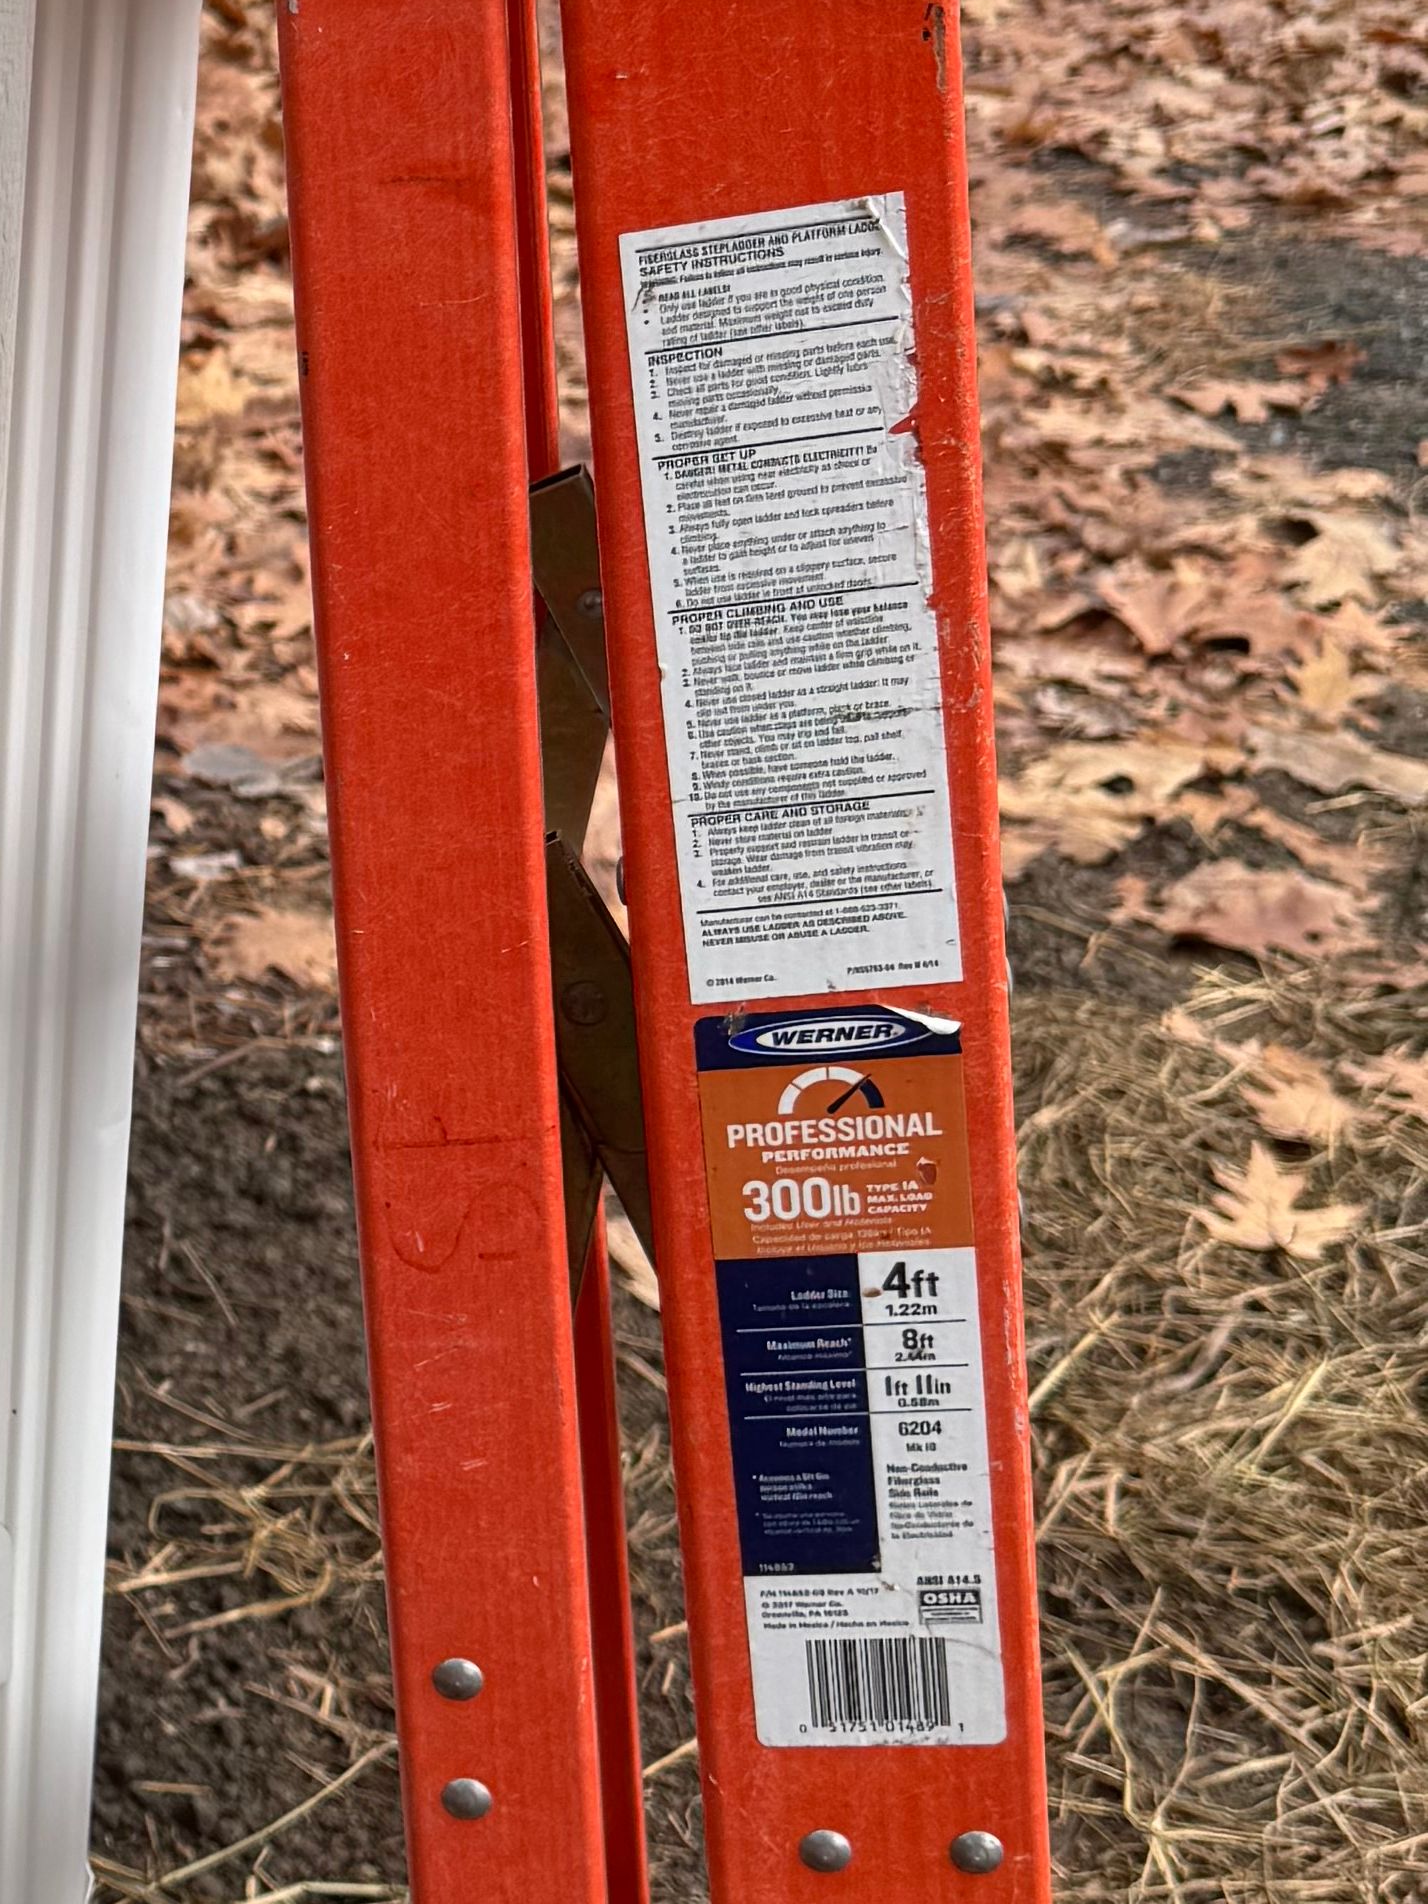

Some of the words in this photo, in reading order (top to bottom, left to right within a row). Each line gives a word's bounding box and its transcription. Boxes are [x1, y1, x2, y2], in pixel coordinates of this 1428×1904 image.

[638, 248, 699, 266] FIBERGLASS
[701, 238, 764, 256] STEPLADDER
[768, 234, 788, 246] AND
[792, 225, 845, 242] PLATFORM
[639, 261, 687, 277] SAFETY
[691, 246, 784, 269] INSTRUCTIONS
[647, 347, 722, 366] INSPECTION
[657, 456, 708, 470] PROPER
[740, 449, 755, 459] UP
[672, 610, 722, 625] PROPER
[726, 603, 785, 618] CLIMBING
[789, 599, 815, 611] AND
[819, 596, 843, 607] USE
[690, 814, 740, 827] PROPER
[744, 810, 778, 822] CARE
[782, 807, 807, 818] AND
[810, 801, 869, 815] STORAGE
[701, 927, 739, 936] ALWAYS
[762, 921, 799, 930] LADDER
[702, 938, 732, 946] NEVER
[771, 1024, 895, 1046] WERNER
[726, 1111, 942, 1148] PROFESSIONAL
[761, 1143, 910, 1162] PERFORMANCE
[866, 1183, 898, 1192] TYPE
[742, 1174, 861, 1222] 300lb
[899, 1192, 932, 1201] LOAD
[867, 1203, 927, 1213] CAPACITY
[881, 1260, 939, 1298] 4ft
[790, 1290, 825, 1300] Ladder
[885, 1302, 936, 1316] 1.22m
[901, 1328, 933, 1349] 8ft
[746, 1381, 783, 1393] Highest
[785, 1379, 828, 1391] Standing
[830, 1378, 855, 1388] Level
[786, 1427, 816, 1436] Model
[819, 1425, 858, 1435] Number
[898, 1420, 941, 1436] 6204
[886, 1461, 967, 1474] Non-Conductive
[887, 1476, 940, 1486] Fiberglass
[923, 1592, 976, 1604] OSHA
